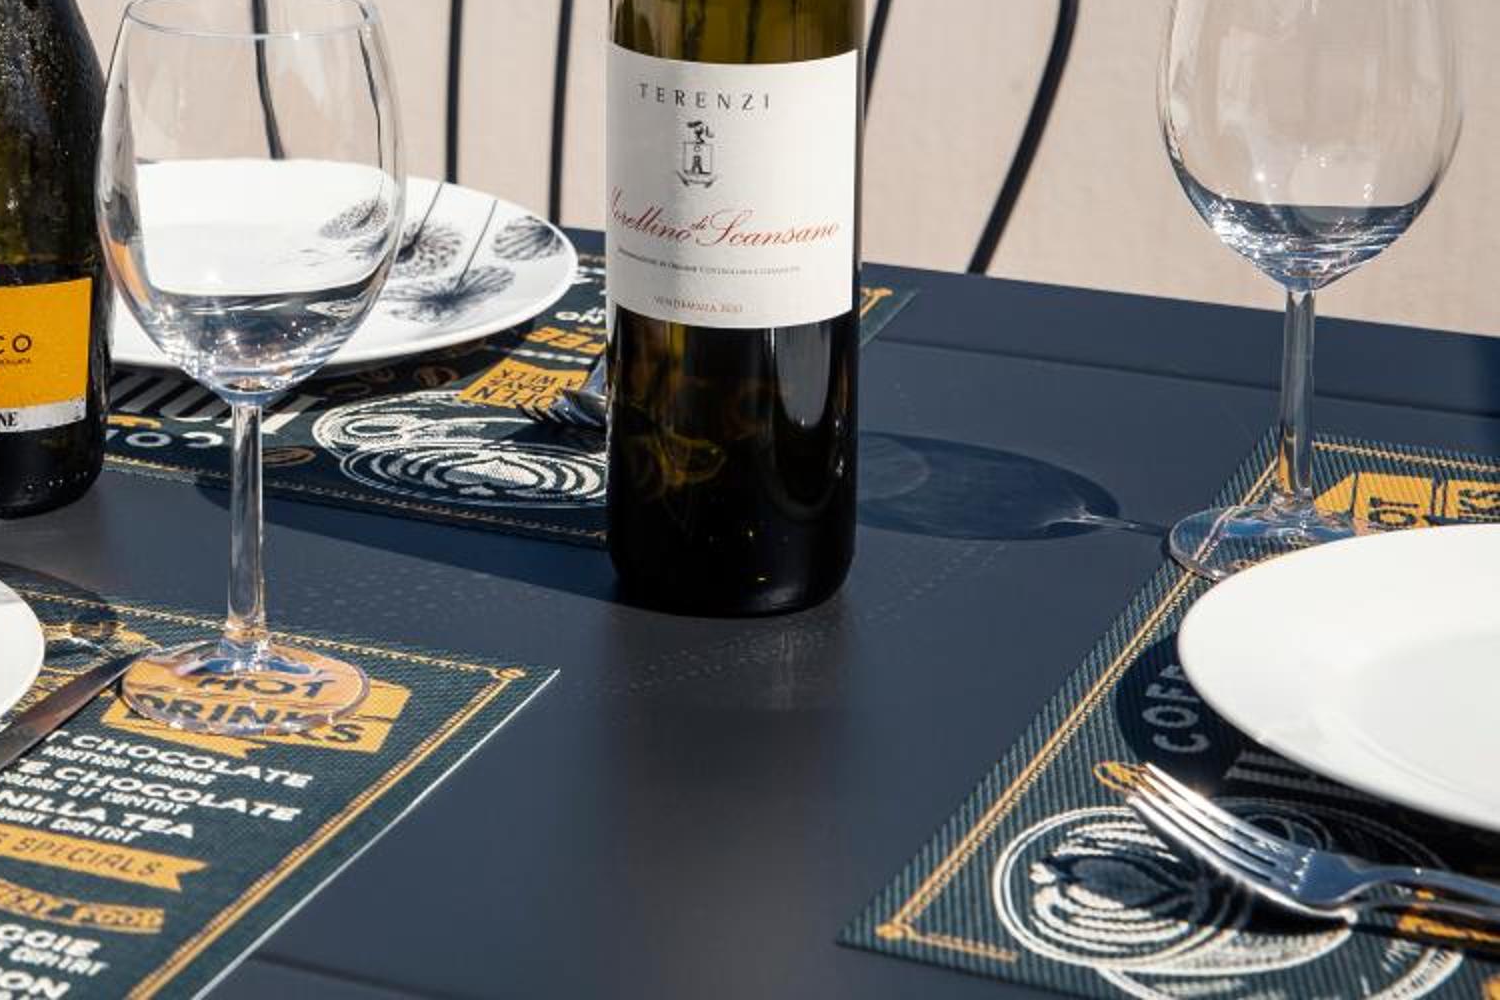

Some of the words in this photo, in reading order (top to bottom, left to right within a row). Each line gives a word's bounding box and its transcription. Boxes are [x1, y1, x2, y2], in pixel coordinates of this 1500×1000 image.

[638, 83, 770, 111] TERENZI
[696, 209, 840, 246] Scansano
[73, 735, 313, 789] CHOCOLATE
[55, 767, 302, 822] CHOCOLATE
[120, 812, 195, 840] TEA
[13, 838, 163, 877] SPECIALS
